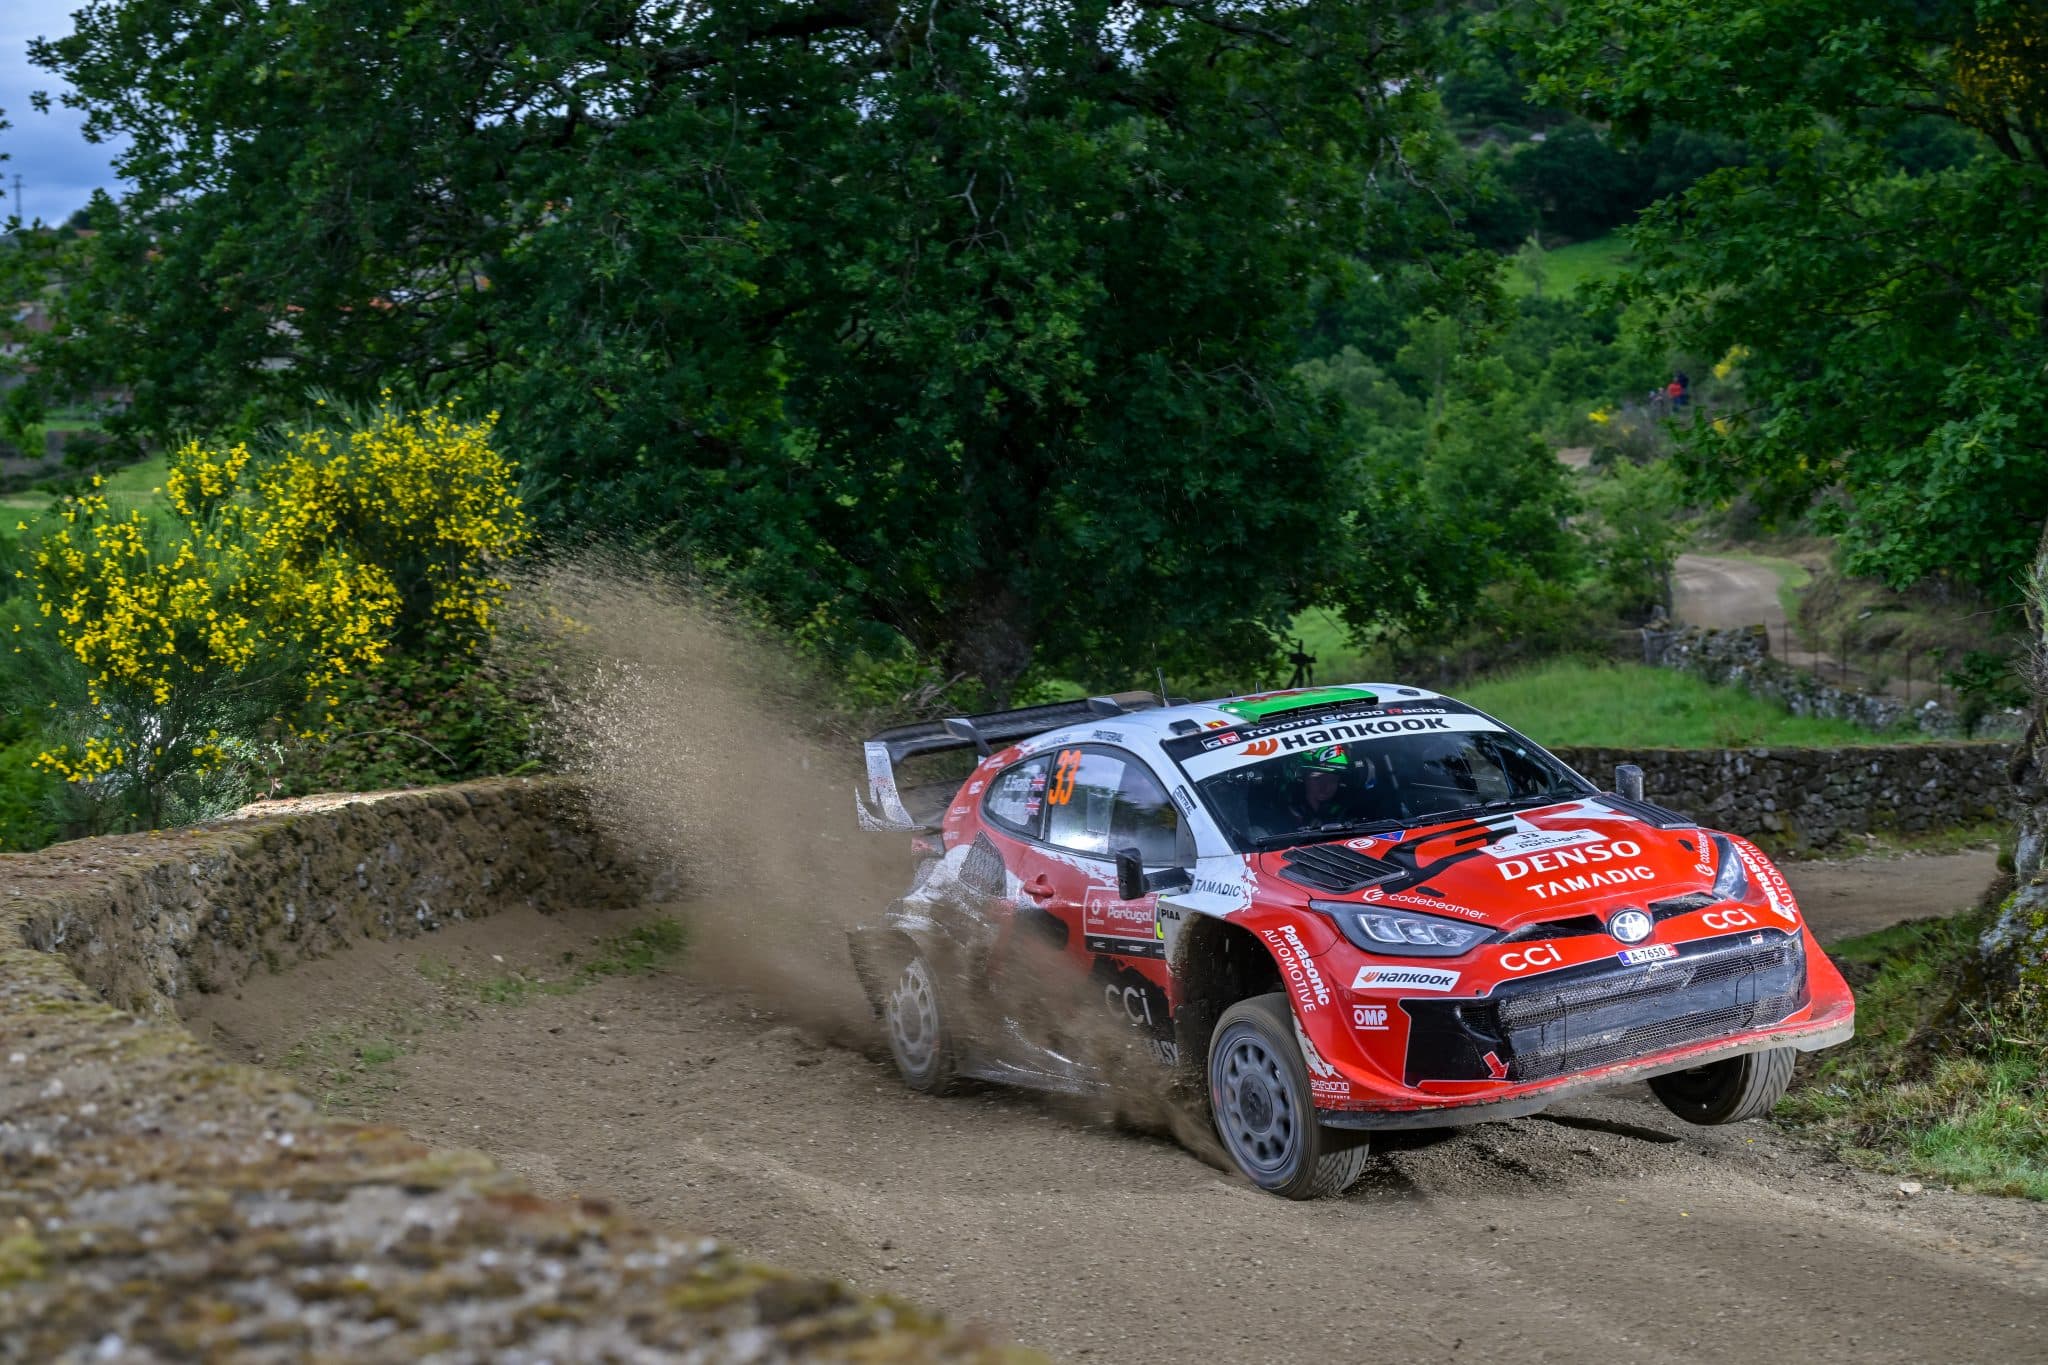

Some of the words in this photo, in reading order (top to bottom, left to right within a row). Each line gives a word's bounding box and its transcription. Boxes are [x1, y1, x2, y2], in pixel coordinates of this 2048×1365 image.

[1243, 718, 1319, 737] TOYOTA
[1321, 710, 1385, 723] GAZOO
[1048, 749, 1083, 805] 33
[1518, 832, 1540, 840] 33
[1496, 840, 1641, 881] DENSO
[1195, 879, 1241, 897] TAMADIC
[1526, 865, 1656, 899] TAMADIC
[1161, 908, 1180, 921] PIAA
[1389, 892, 1489, 920] codebeamer
[1278, 924, 1331, 1006] Panasonic
[1631, 947, 1666, 962] A-7650
[1261, 929, 1316, 1013] AUTOMOTIVE
[1353, 1009, 1388, 1026] OMP
